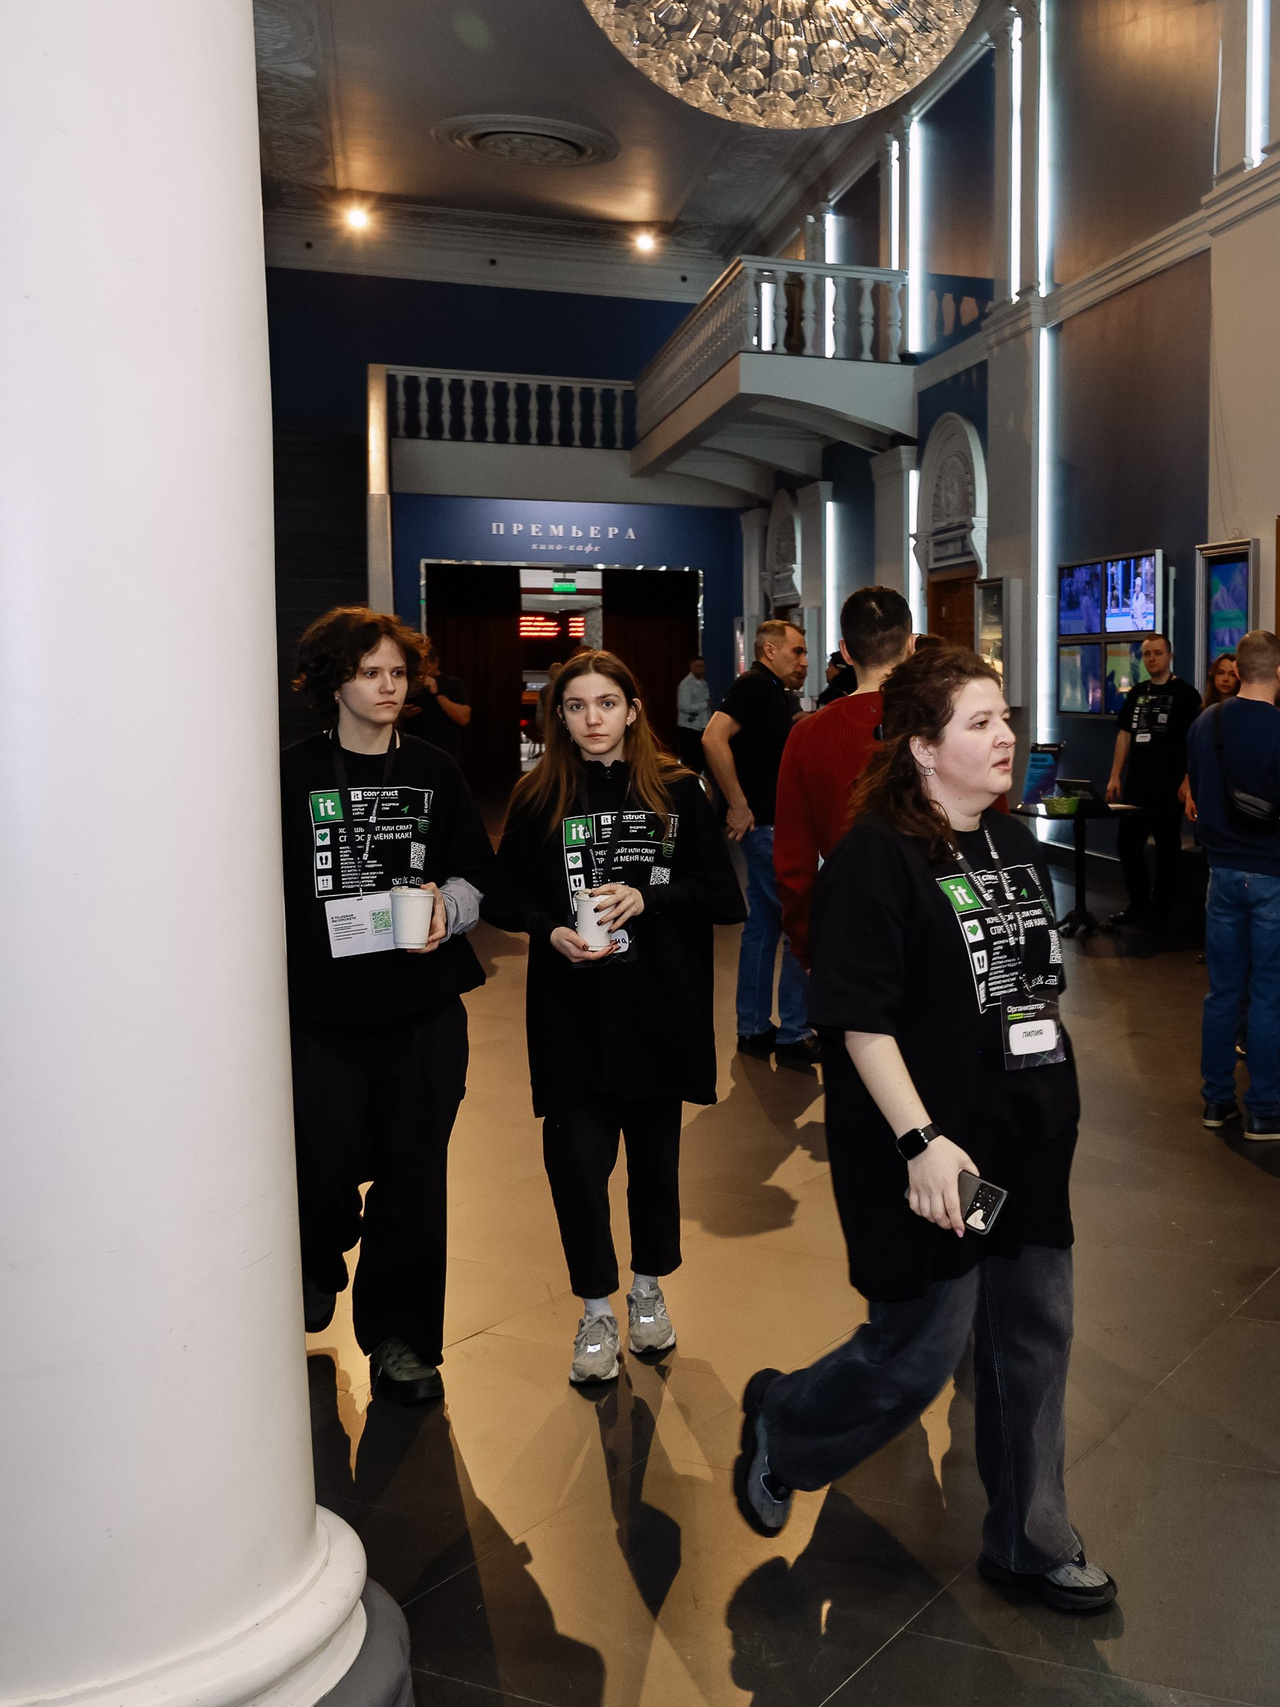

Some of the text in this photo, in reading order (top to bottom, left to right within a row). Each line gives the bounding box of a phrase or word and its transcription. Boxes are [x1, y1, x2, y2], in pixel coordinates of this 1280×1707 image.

[491, 522, 636, 540] ПРЕМЬЕРА
[531, 542, 601, 553] кино-кафе
[362, 790, 399, 798] conruct
[318, 797, 336, 817] it
[395, 831, 412, 840] КАК!
[620, 855, 639, 863] МЕНЯ
[948, 884, 974, 906] it
[1006, 1003, 1046, 1014] Организатор
